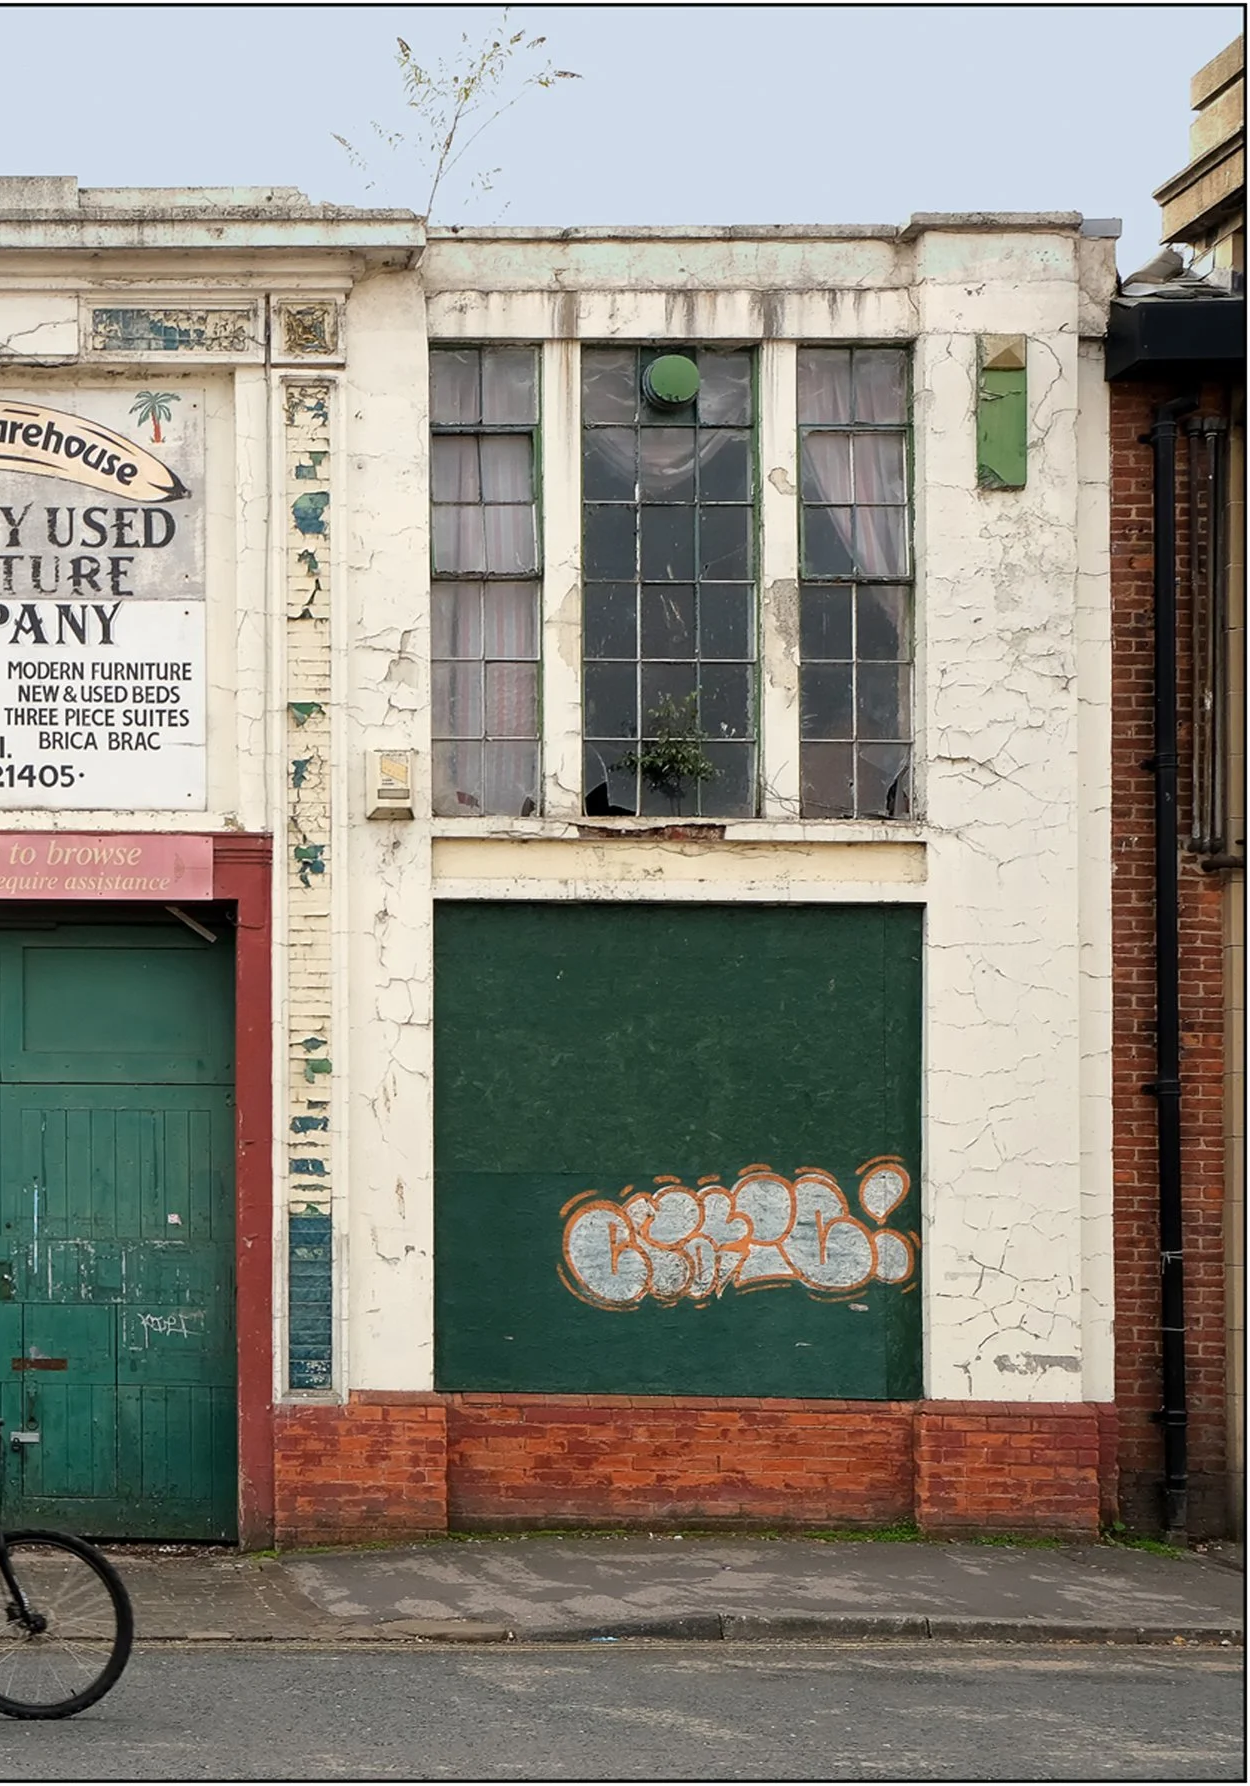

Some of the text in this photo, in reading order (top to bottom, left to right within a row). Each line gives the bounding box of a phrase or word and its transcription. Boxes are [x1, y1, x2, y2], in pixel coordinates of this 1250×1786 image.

[46, 506, 176, 549] USED
[7, 661, 192, 681] MODERN FURNITURE
[18, 684, 181, 704] NEW & USED BEDS
[3, 707, 190, 727] THREE PIECE SUITES
[39, 731, 161, 751] BRICA BRAC
[9, 844, 35, 865] to
[46, 840, 142, 865] browse
[65, 874, 170, 890] assistance
